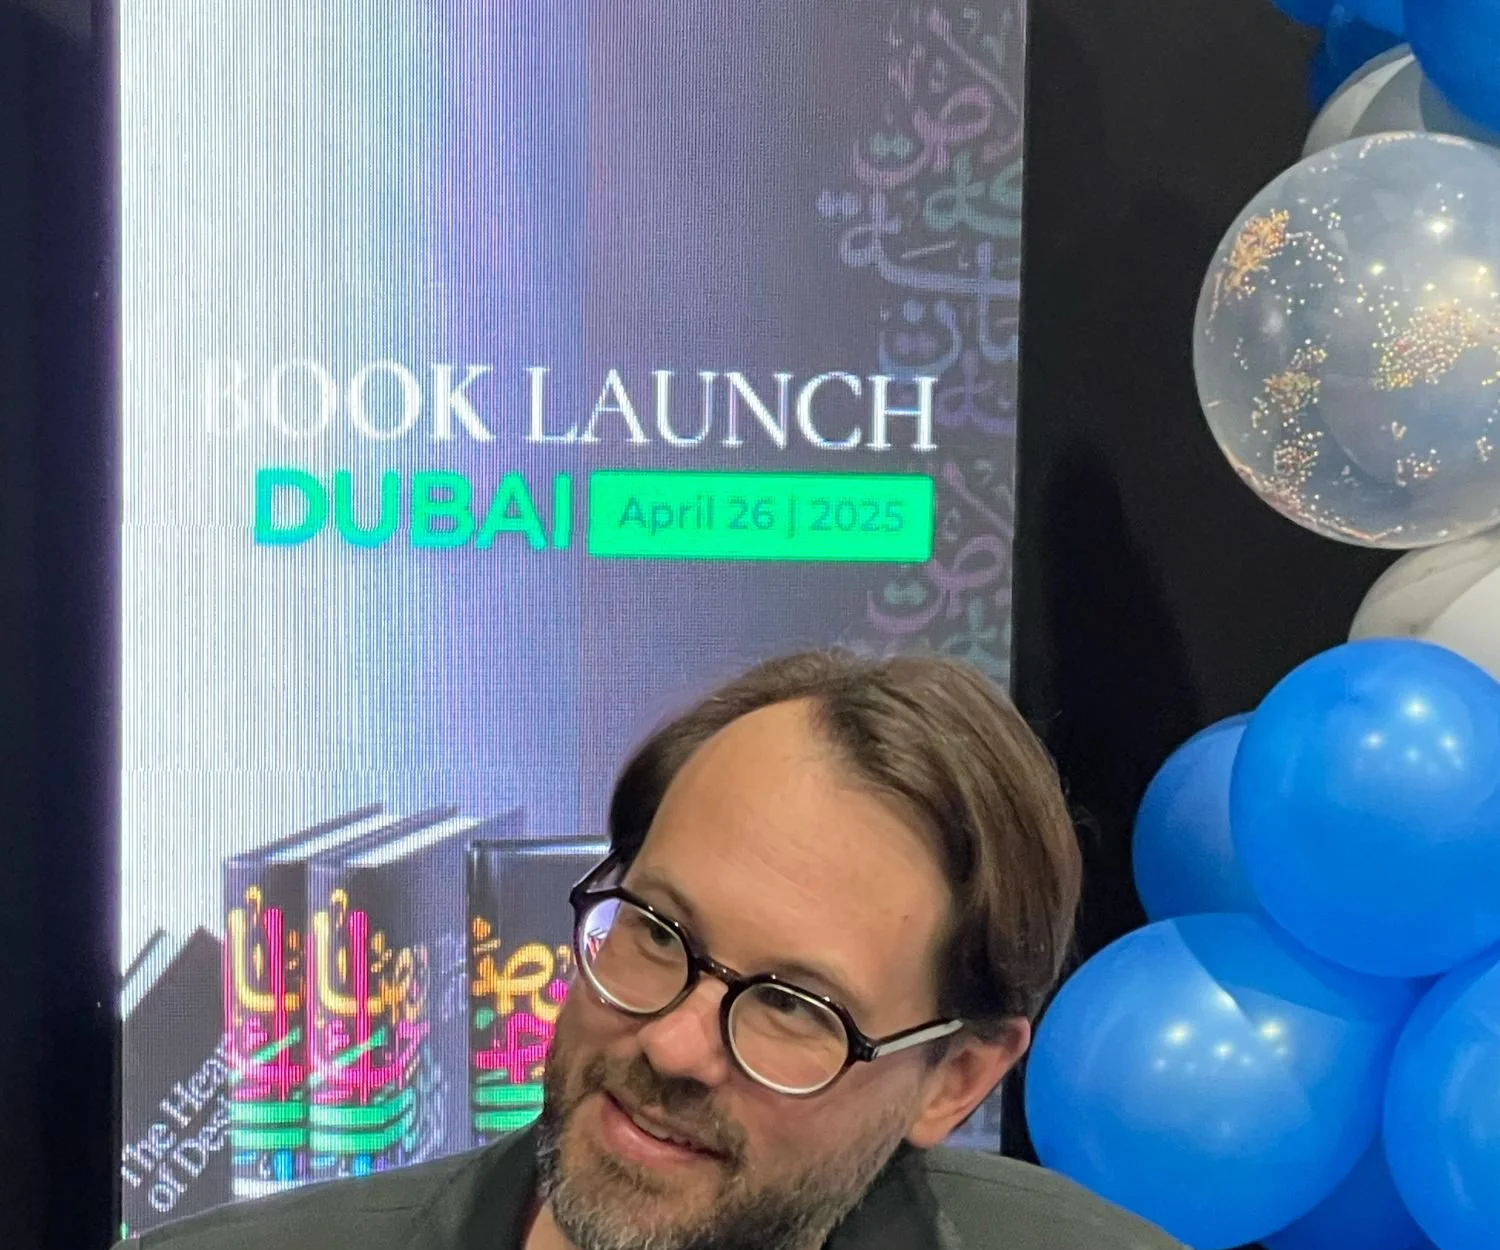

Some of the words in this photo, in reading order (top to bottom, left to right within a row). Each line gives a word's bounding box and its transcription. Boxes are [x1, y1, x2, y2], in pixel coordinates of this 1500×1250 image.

[203, 355, 496, 442] BOOK
[524, 366, 939, 451] LAUNCH
[254, 466, 573, 550] DUBAI
[619, 496, 715, 536] April
[729, 497, 774, 531] 26
[810, 500, 905, 533] 2025
[160, 1034, 226, 1128] Hea
[149, 1162, 188, 1212] of
[173, 1094, 231, 1178] Des
